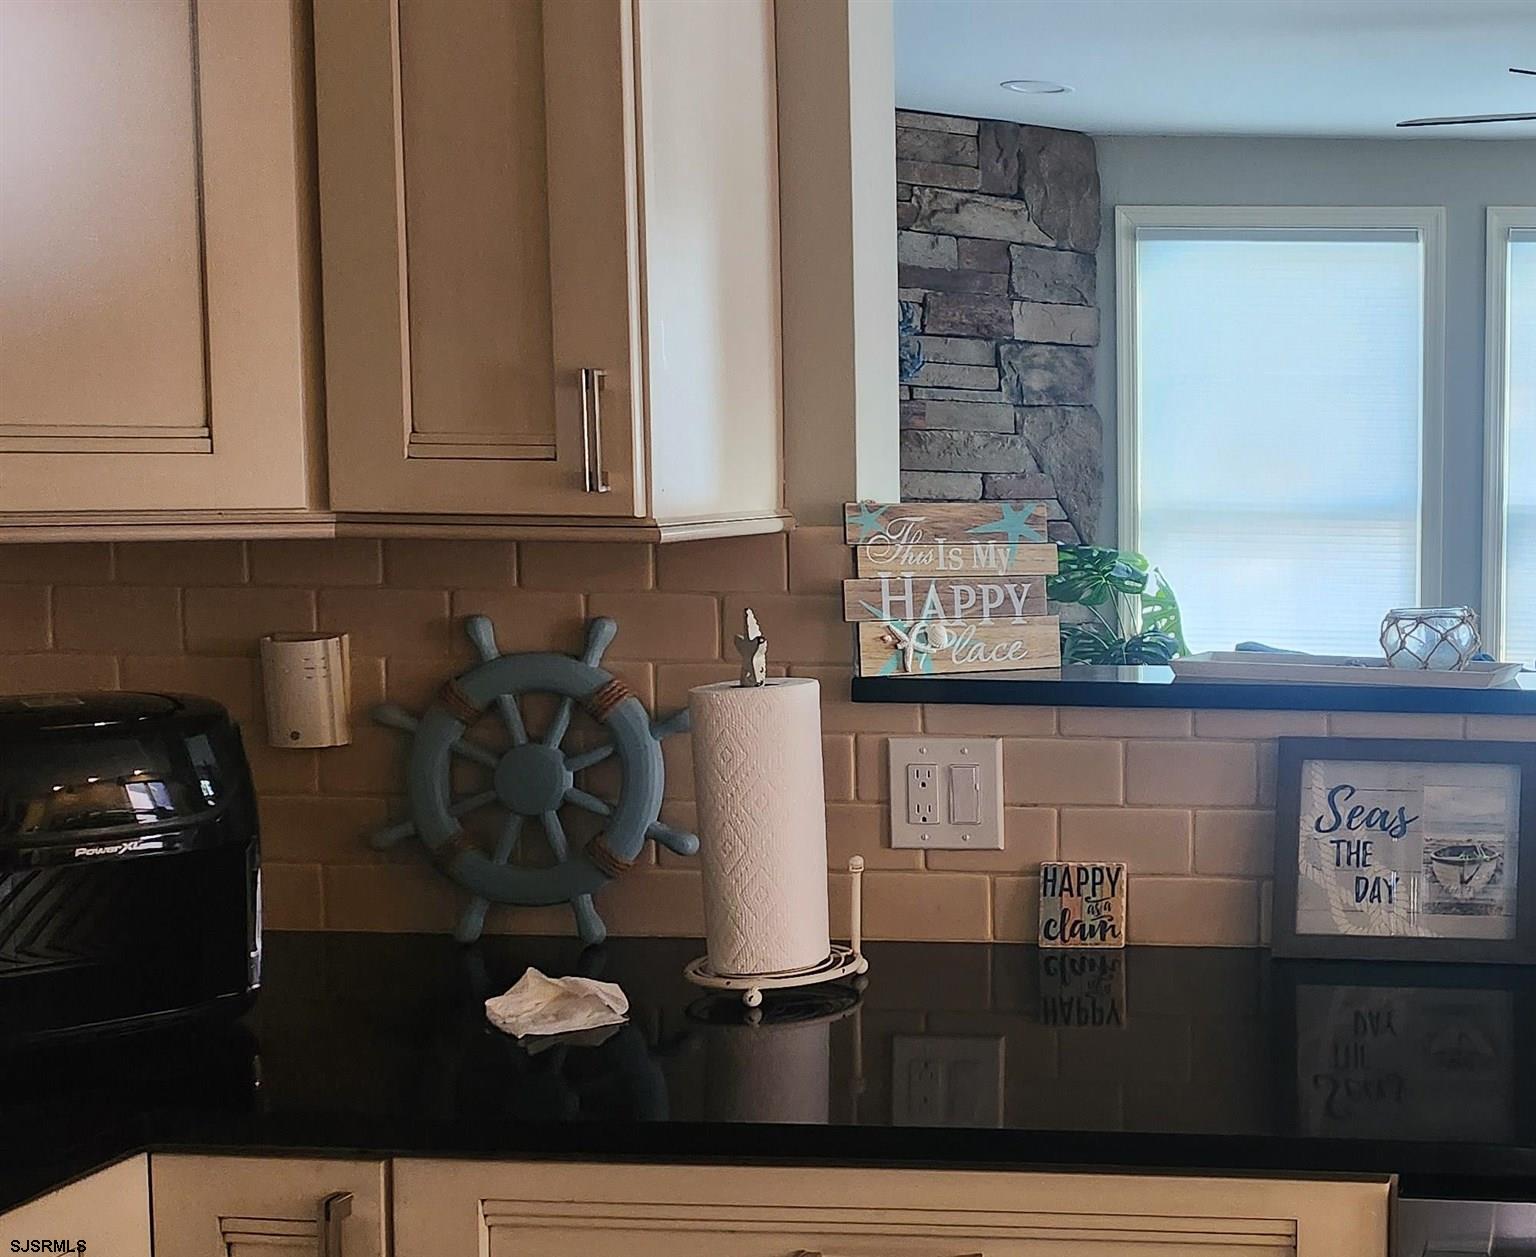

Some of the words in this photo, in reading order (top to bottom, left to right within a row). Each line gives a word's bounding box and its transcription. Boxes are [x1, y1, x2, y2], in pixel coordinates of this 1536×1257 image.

[866, 516, 934, 566] This
[935, 537, 964, 571] Is
[972, 540, 1011, 576] My
[877, 572, 1032, 628] HAPPY
[1314, 784, 1419, 839] Seas
[1330, 839, 1373, 868] THE
[1043, 866, 1122, 898] HAPPY
[1355, 876, 1400, 904] DAY
[1043, 907, 1122, 944] clam
[1087, 902, 1100, 916] as
[1103, 901, 1112, 912] a
